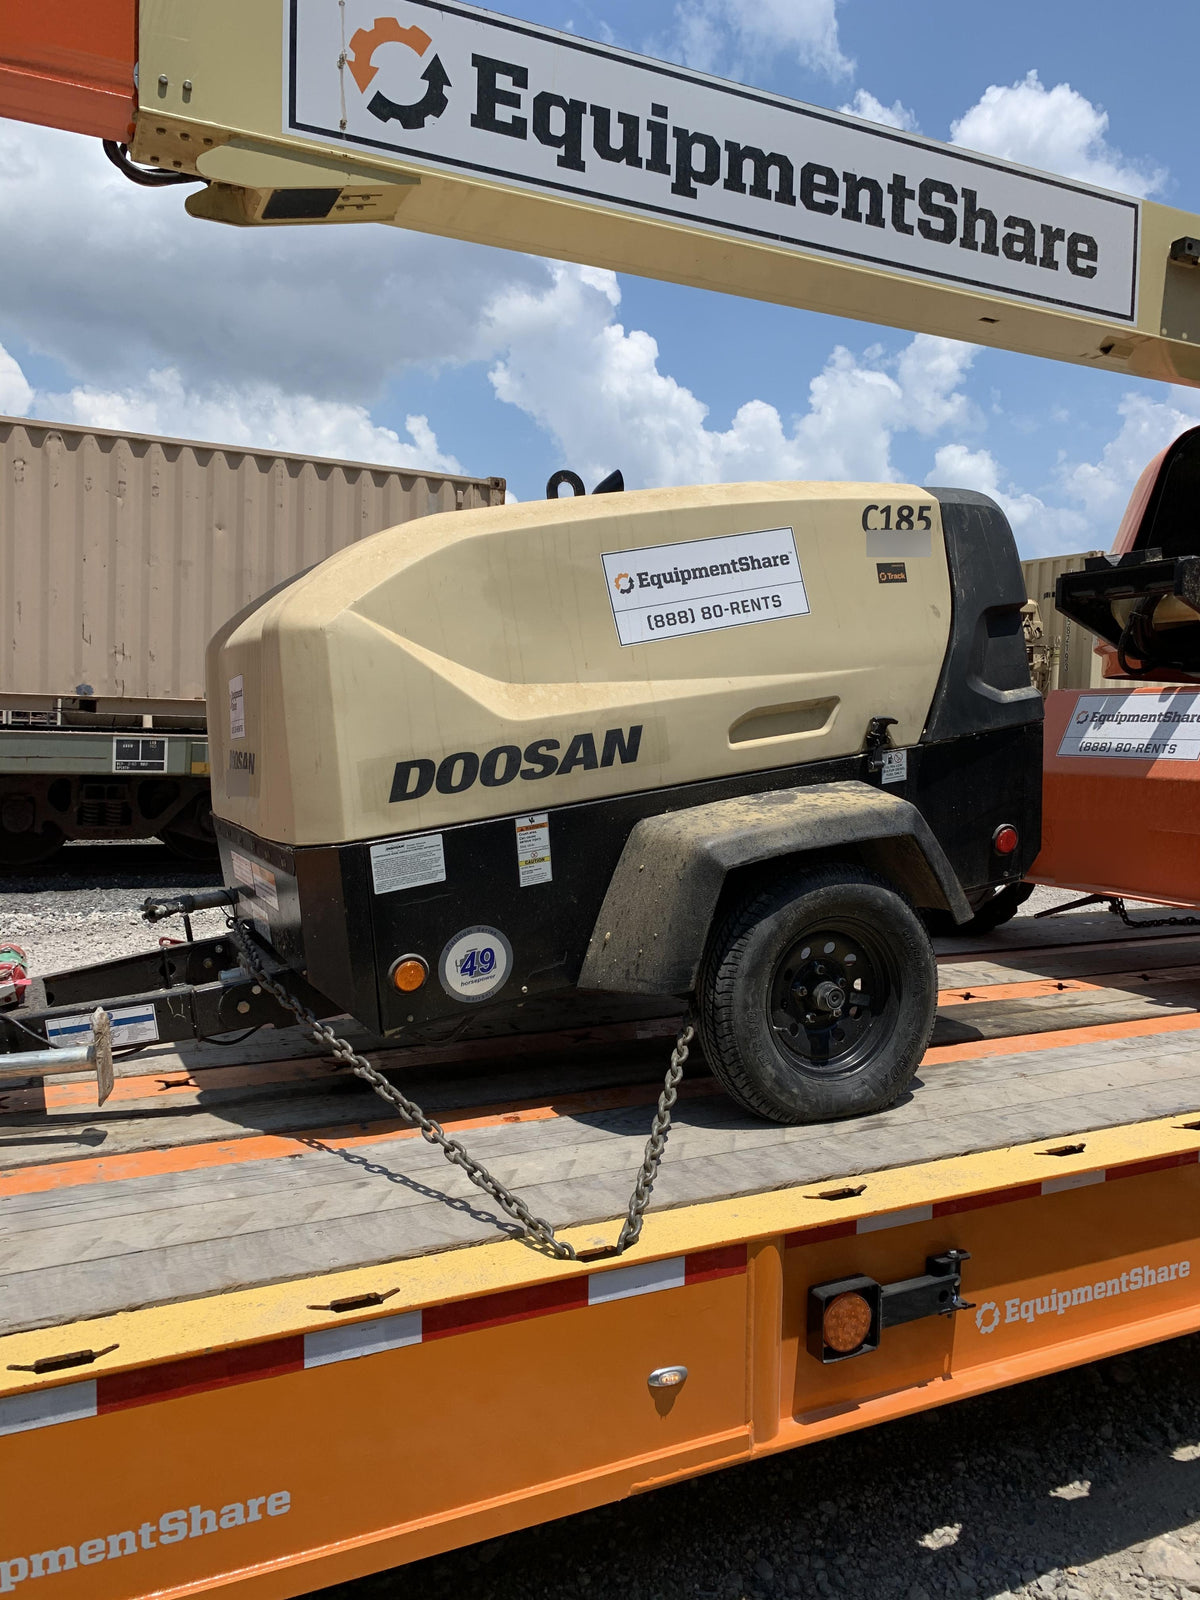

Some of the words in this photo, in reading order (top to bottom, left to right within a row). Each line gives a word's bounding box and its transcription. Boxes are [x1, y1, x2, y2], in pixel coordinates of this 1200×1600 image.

[471, 53, 1099, 279] EquipmentShare
[862, 504, 932, 533] C185
[636, 553, 790, 590] EquipmentShare
[647, 608, 696, 631] (888)
[701, 594, 783, 621] 80-RENTS
[389, 725, 643, 803] DOOSAN
[1079, 741, 1113, 753] (888)
[1115, 742, 1178, 755] 80-RENTS
[460, 947, 496, 977] 49
[1004, 1260, 1191, 1323] EquipmentShare
[0, 1490, 291, 1593] pmentShare
